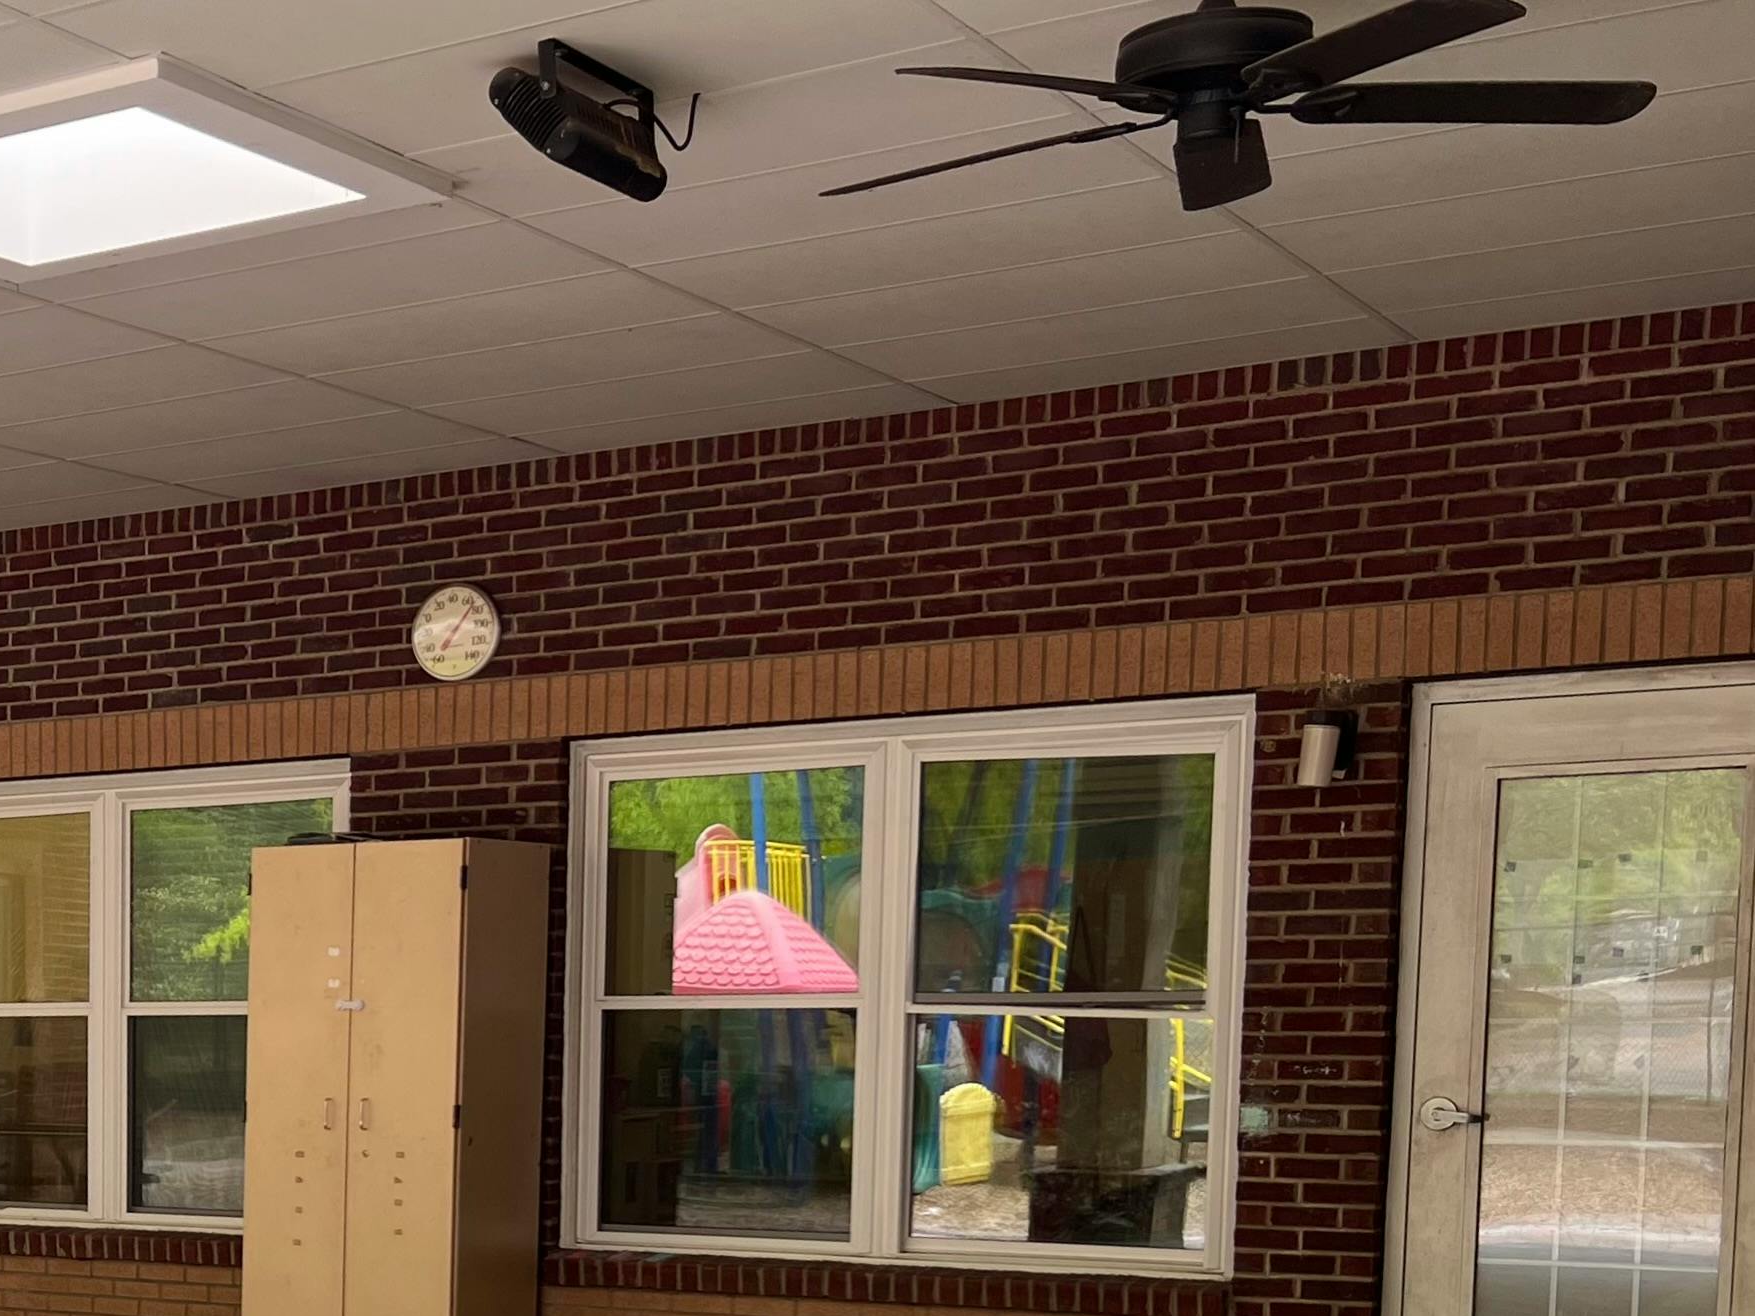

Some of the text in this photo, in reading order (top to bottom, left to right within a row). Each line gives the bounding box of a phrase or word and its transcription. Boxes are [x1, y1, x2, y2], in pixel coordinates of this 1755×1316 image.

[447, 592, 459, 604] 40
[461, 595, 474, 606] 60
[434, 598, 445, 611] 20
[472, 605, 484, 615] 80
[425, 613, 432, 623] 0
[472, 635, 486, 646] 120
[464, 650, 480, 661] 140
